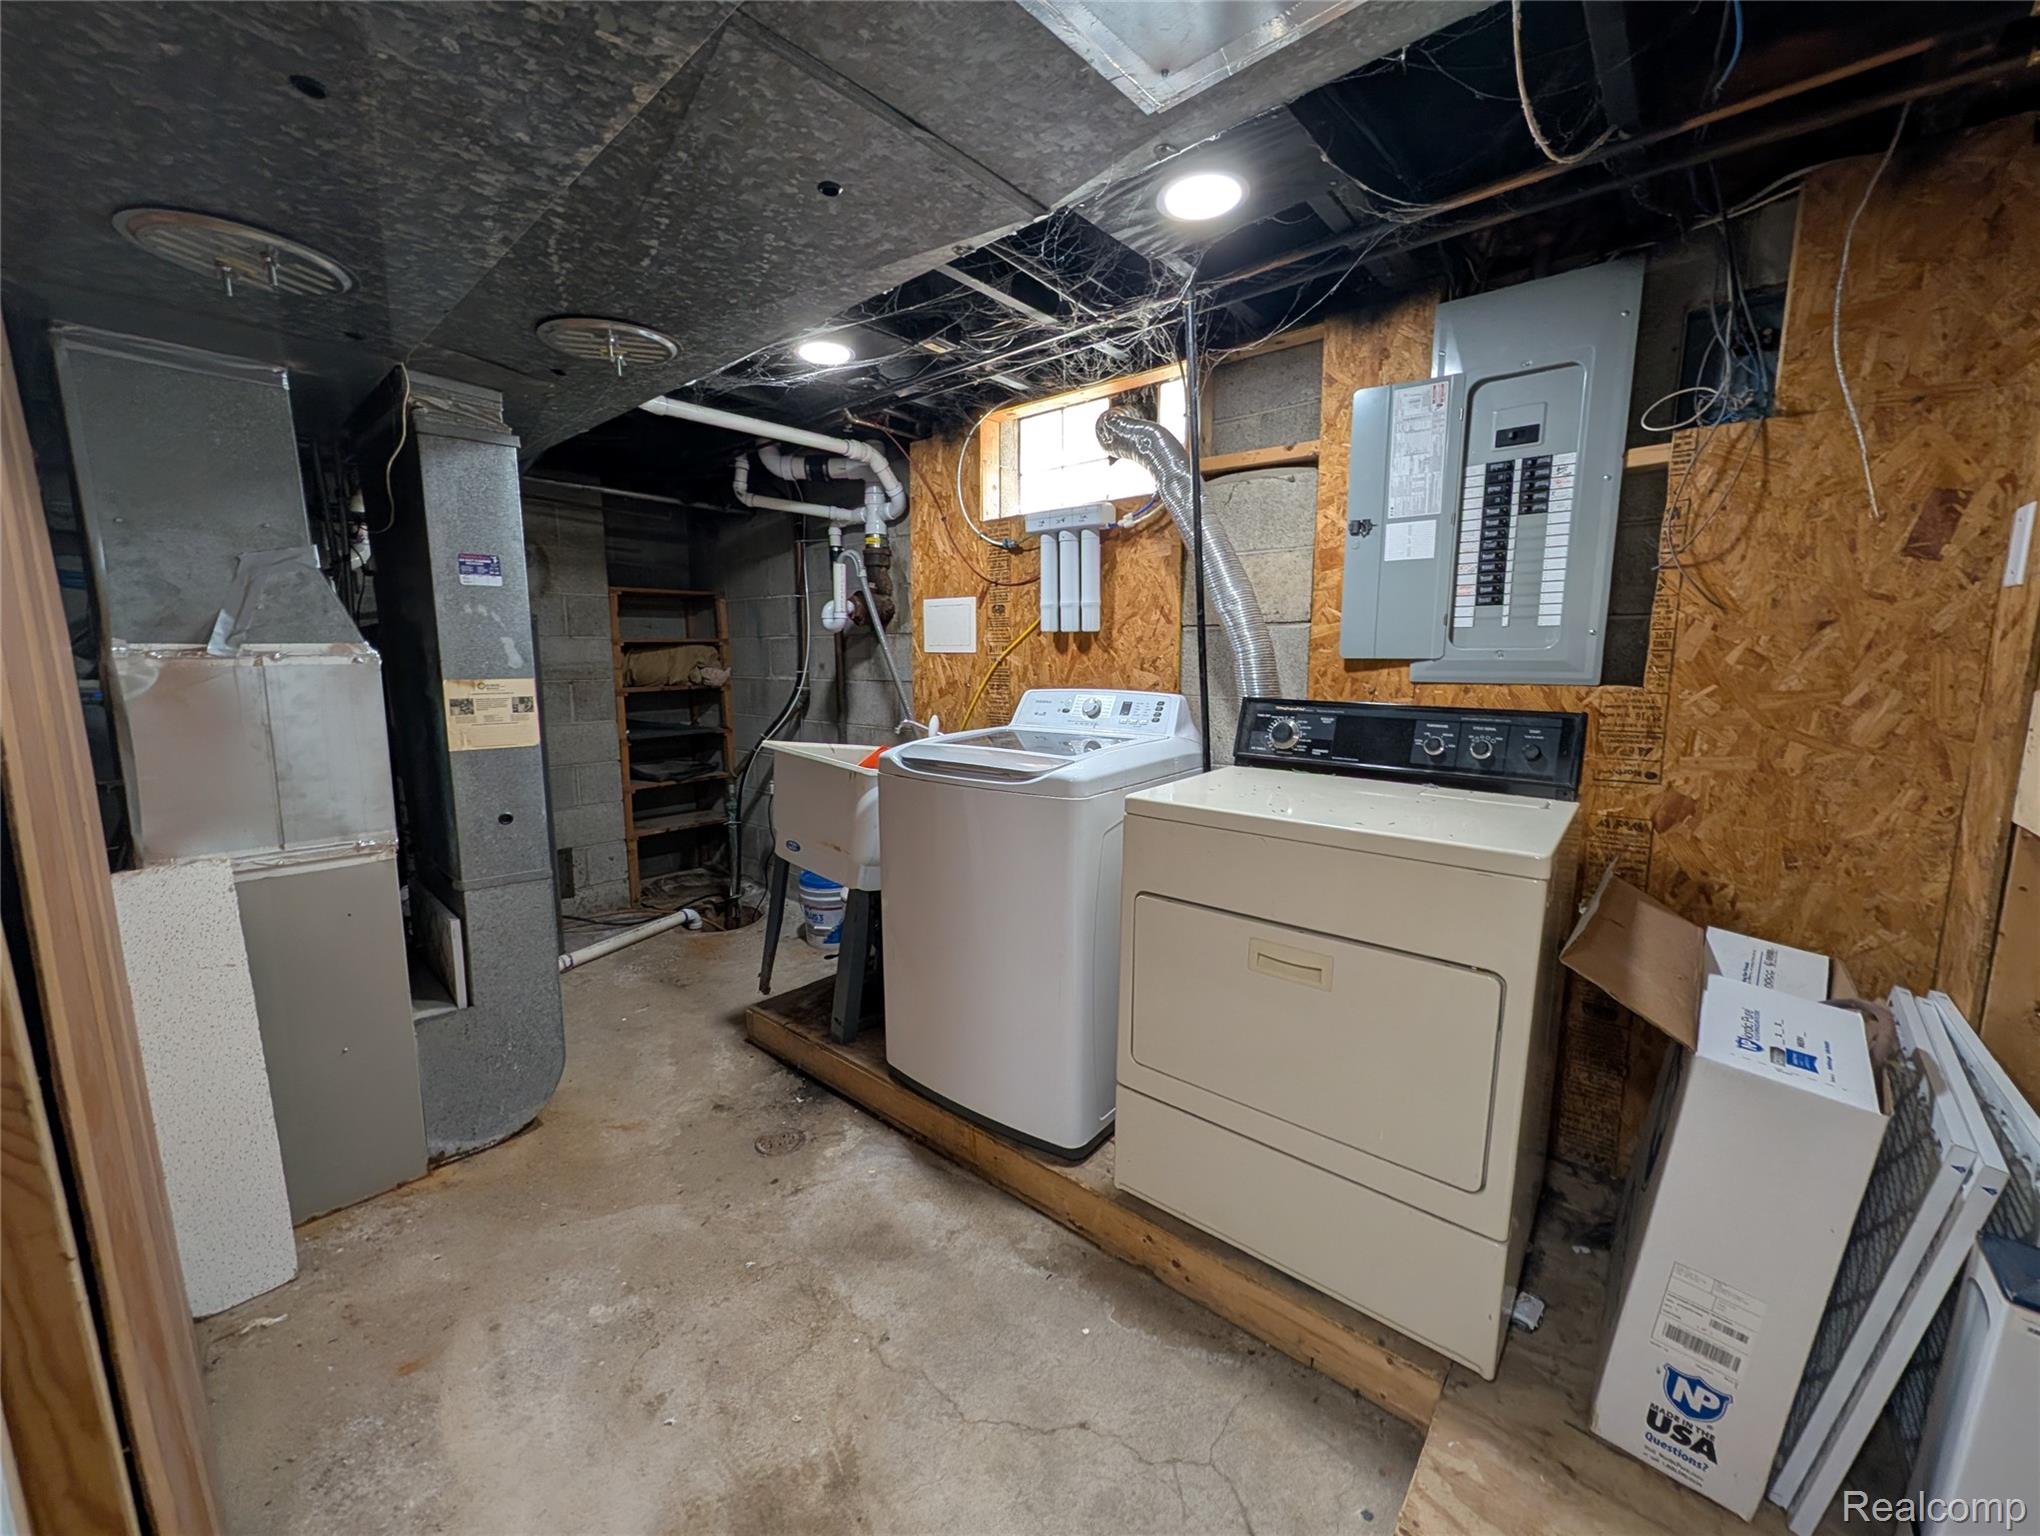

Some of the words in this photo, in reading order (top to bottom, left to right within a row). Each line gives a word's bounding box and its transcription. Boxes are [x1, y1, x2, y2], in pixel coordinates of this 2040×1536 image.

[1672, 1376, 1720, 1413] NP
[1646, 1409, 1718, 1465] USA
[1650, 1403, 1681, 1422] MADE
[1682, 1419, 1694, 1430] IN
[1695, 1426, 1716, 1441] THE
[1645, 1431, 1709, 1473] Questions?
